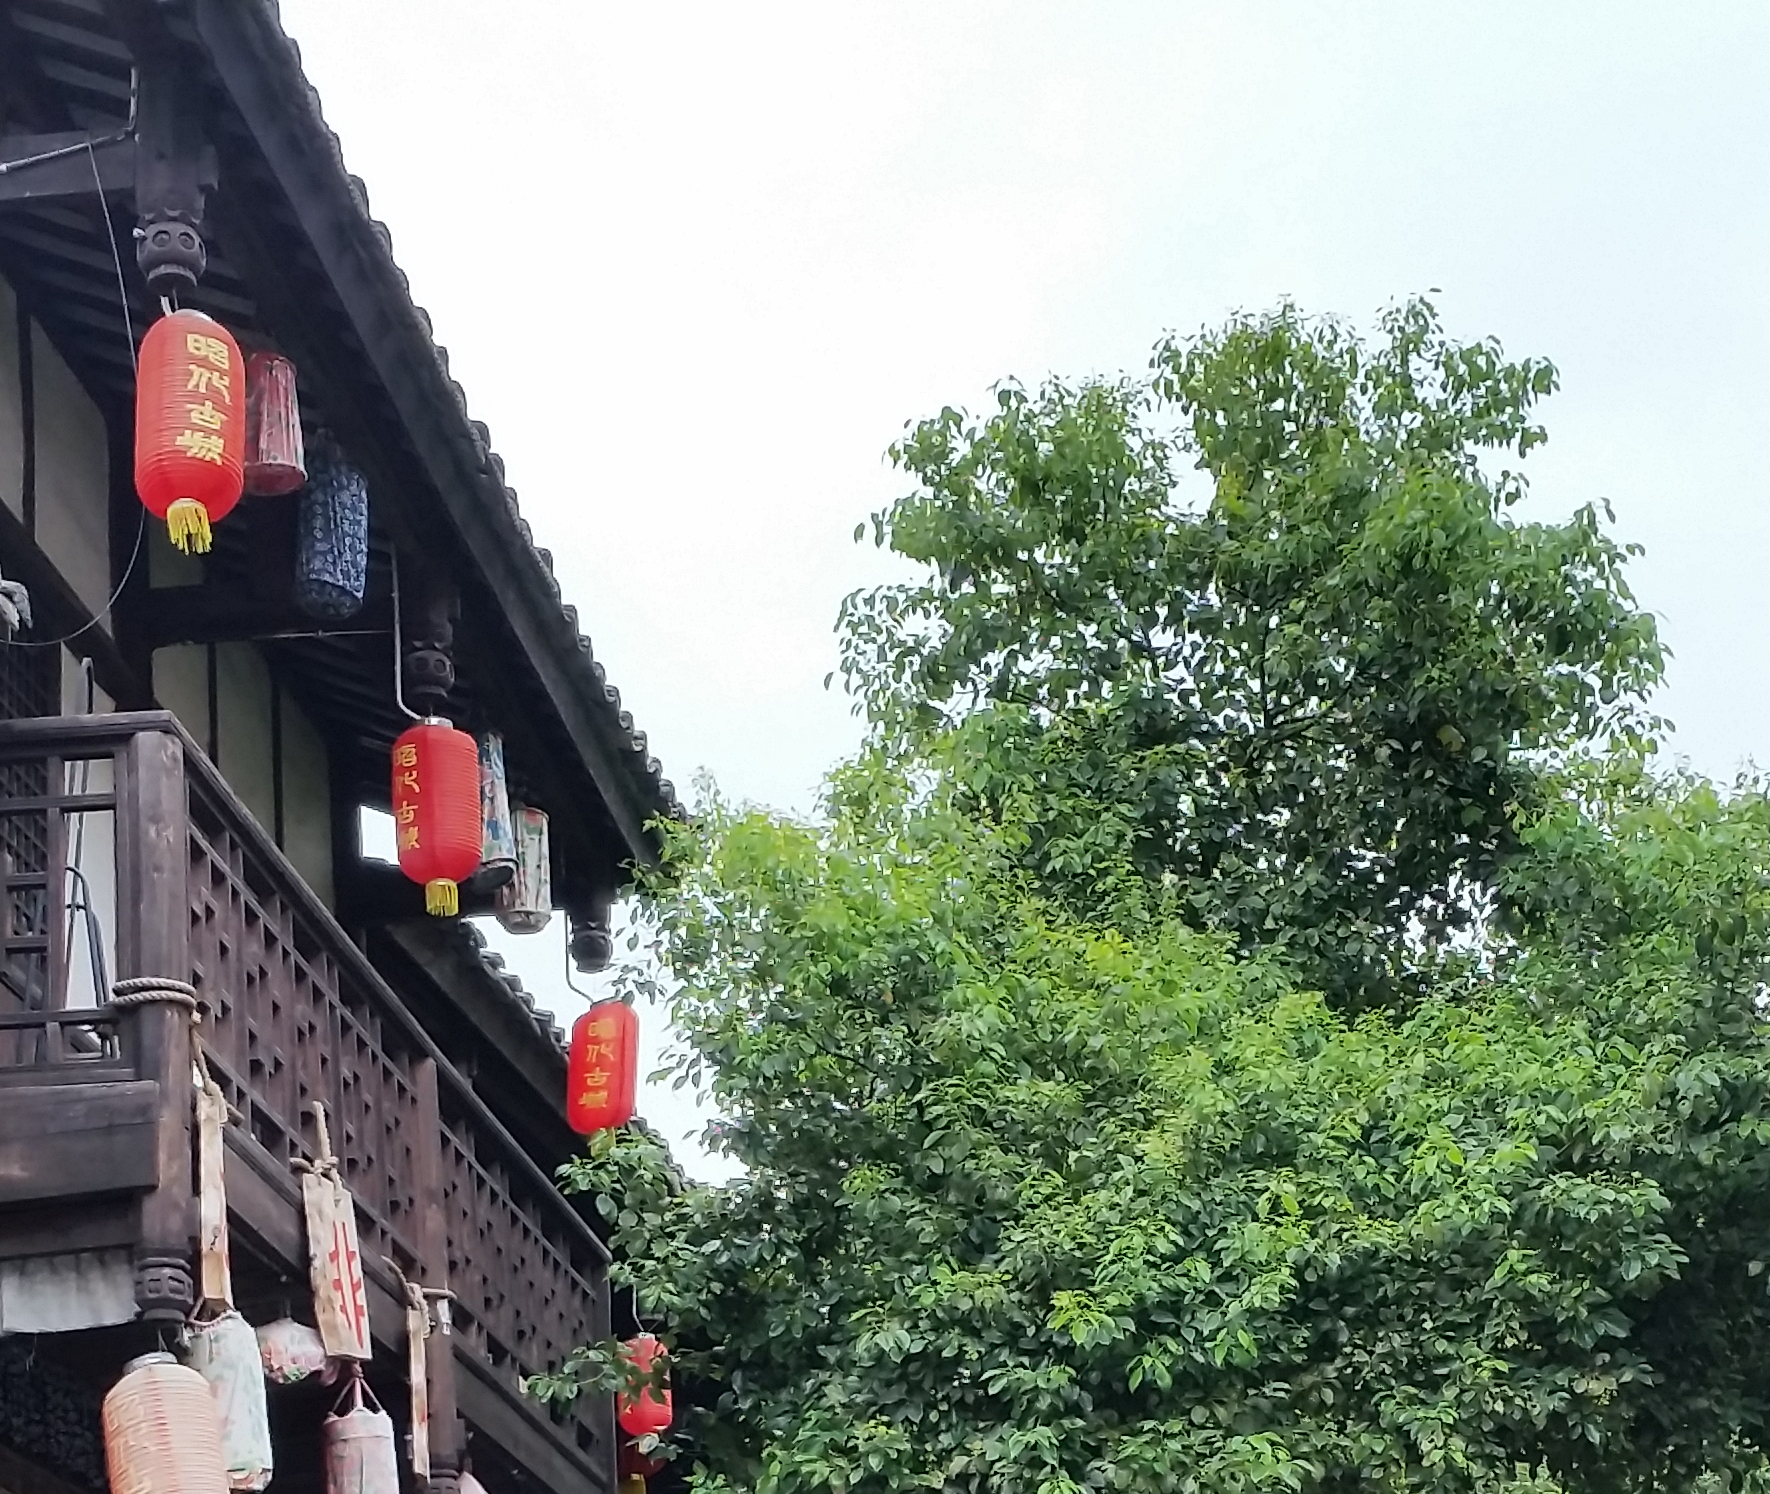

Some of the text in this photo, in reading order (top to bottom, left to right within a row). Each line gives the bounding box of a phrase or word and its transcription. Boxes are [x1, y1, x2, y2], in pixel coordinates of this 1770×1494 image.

[175, 333, 232, 467] 昭化古城
[579, 1018, 615, 1109] 昭化古城
